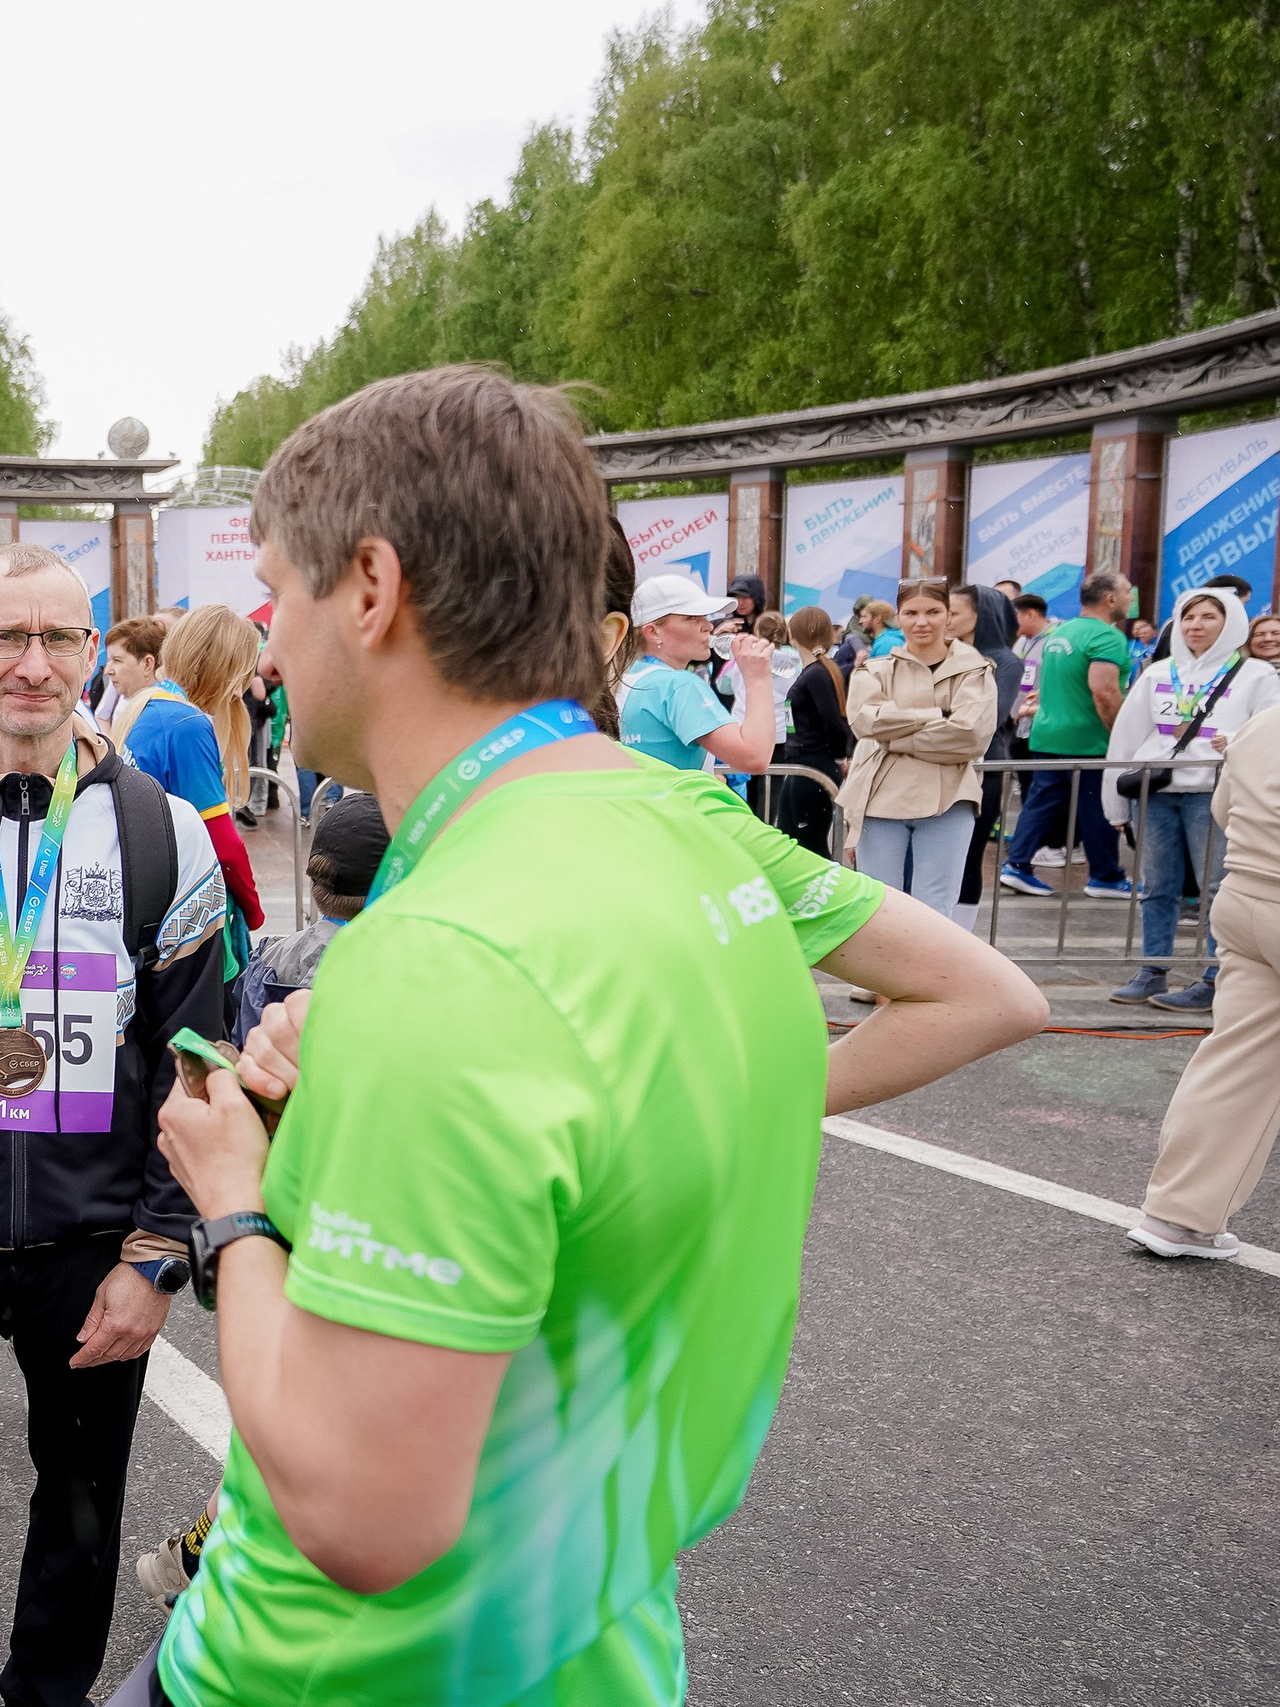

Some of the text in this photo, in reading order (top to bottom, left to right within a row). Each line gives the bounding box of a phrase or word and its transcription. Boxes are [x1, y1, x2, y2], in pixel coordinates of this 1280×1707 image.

[1021, 464, 1088, 514] ВМЕСТЕ
[1175, 438, 1268, 512] ФЕСТИВАЛЬ
[229, 518, 250, 527] ФЕ
[804, 498, 854, 531] БЫТЬ
[810, 487, 895, 548] ДВИЖЕНИИ
[1178, 477, 1280, 567] ДВИЖЕНИЕ
[211, 533, 250, 543] ПЕРВ
[628, 519, 675, 549] БЫТЬ
[638, 508, 718, 564] РОССИЕЙ
[206, 550, 256, 561] ХАНТЫ
[478, 728, 526, 761] СБЕР
[407, 819, 428, 844] 185
[800, 865, 841, 918] рит
[23, 909, 36, 933] СБЕР
[0, 950, 8, 967] 185
[19, 1060, 40, 1068] СБЕР
